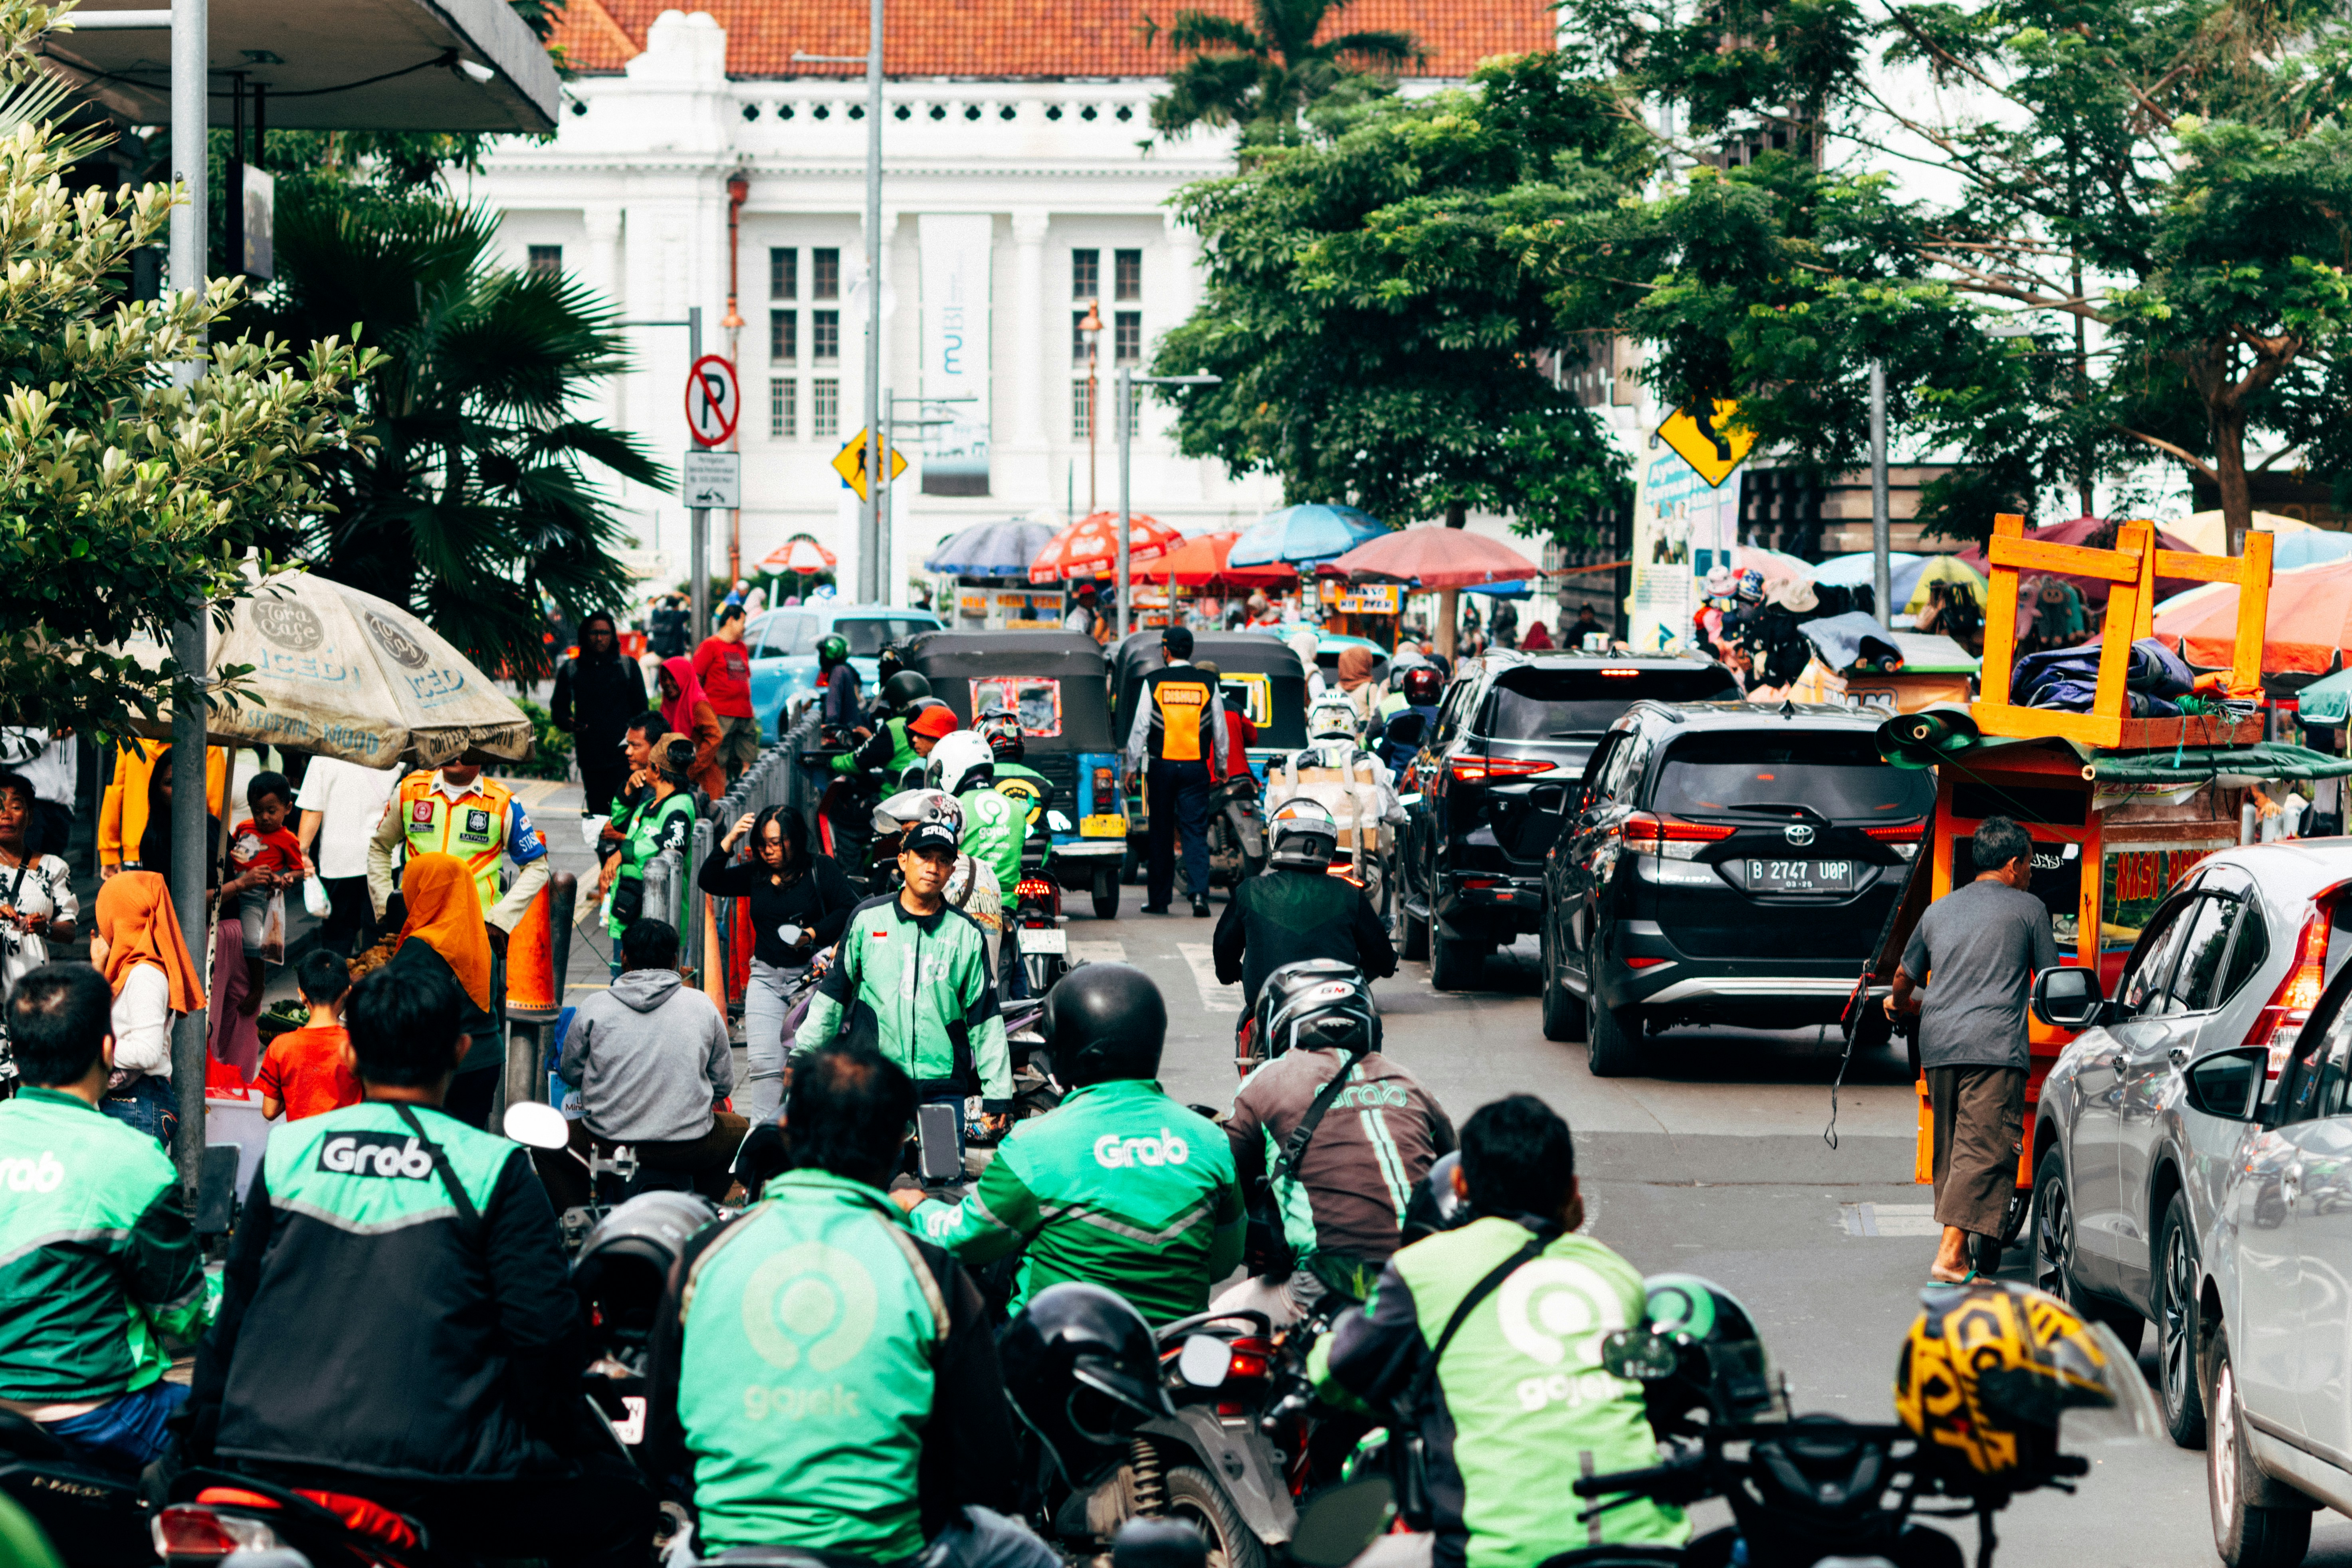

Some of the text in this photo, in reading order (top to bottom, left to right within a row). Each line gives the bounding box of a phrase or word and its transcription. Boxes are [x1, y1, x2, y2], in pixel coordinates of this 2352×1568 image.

[257, 601, 311, 623] Tora
[370, 617, 393, 640] To
[383, 638, 418, 659] Caf
[1163, 689, 1201, 704] DISHUB
[323, 722, 379, 755] MOOD
[461, 833, 488, 843] SATPAM
[921, 825, 954, 844] ERIGO
[979, 824, 1011, 839] gojek
[1753, 862, 1763, 880] B
[1770, 862, 1808, 880] 2747
[2117, 852, 2160, 901] NASI
[323, 1137, 432, 1178] Grab
[1093, 1127, 1189, 1169] Grab
[743, 1384, 861, 1421] gojek
